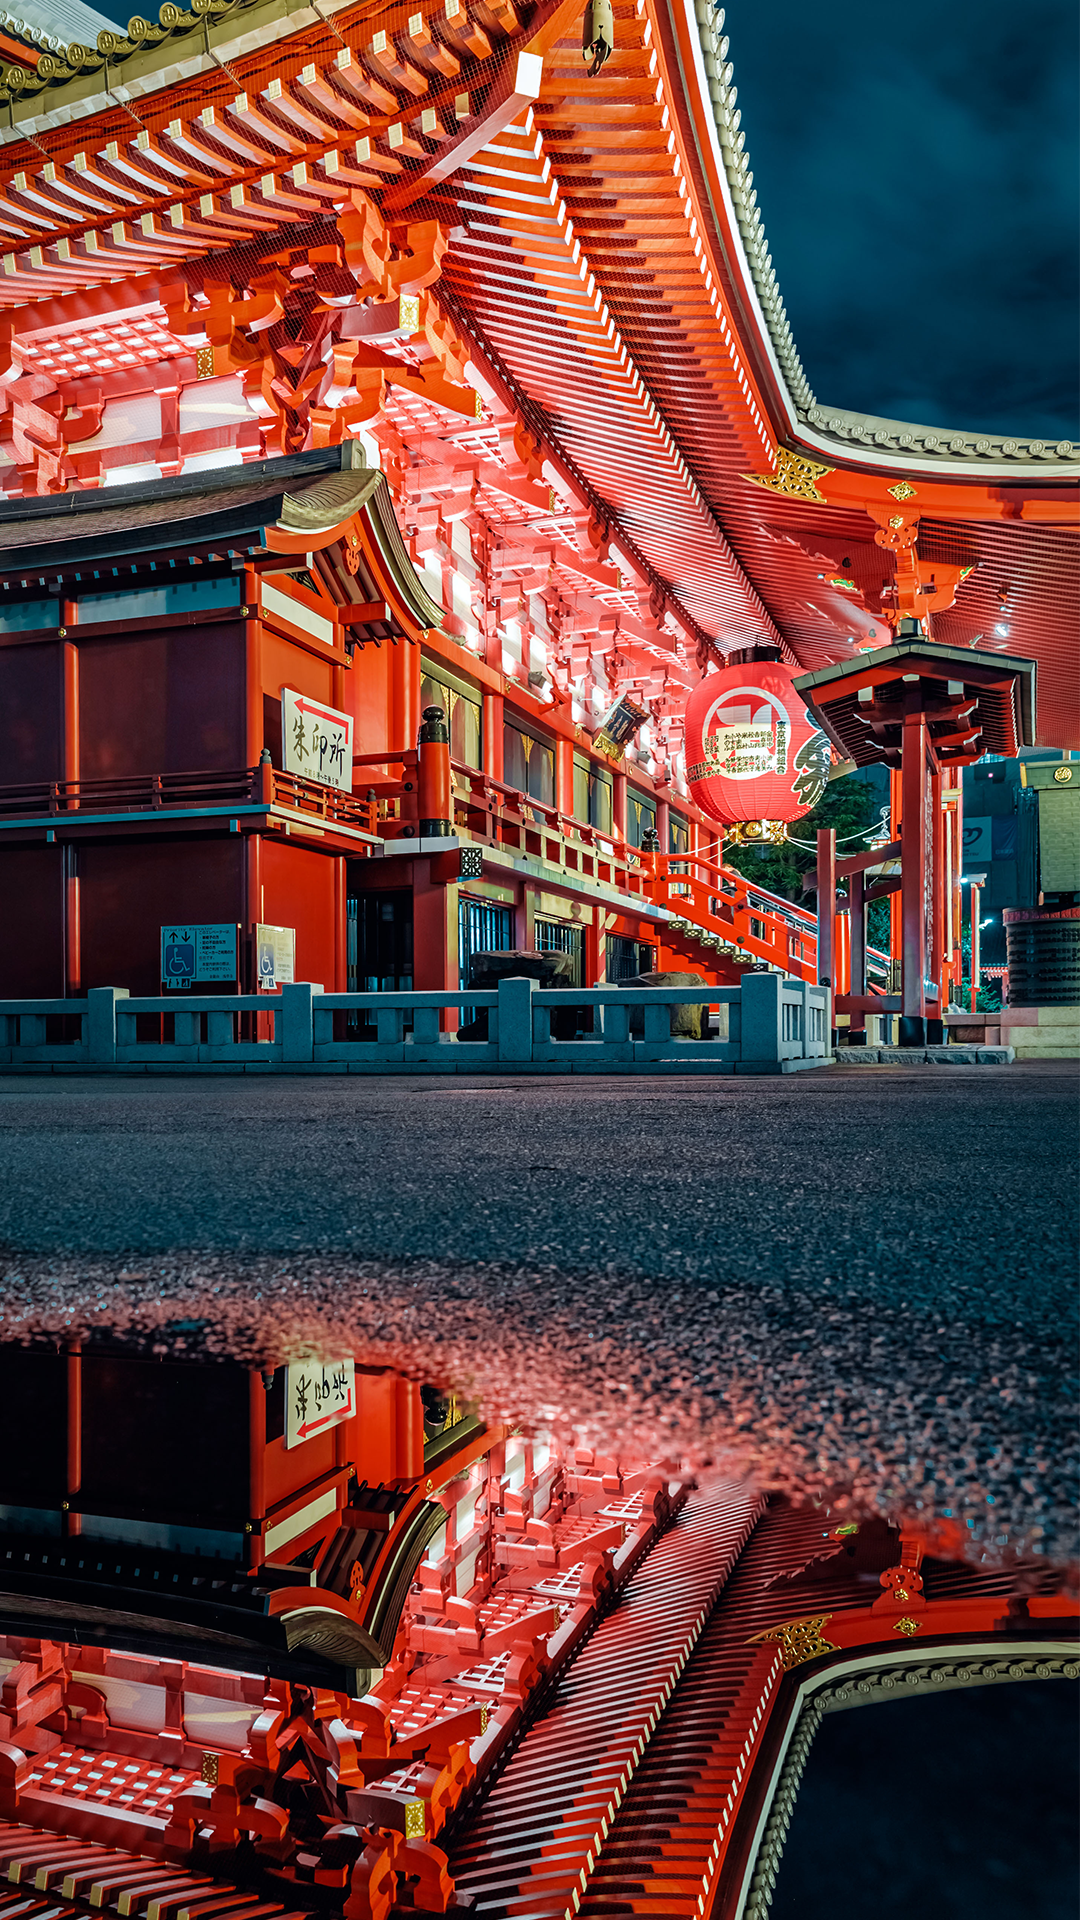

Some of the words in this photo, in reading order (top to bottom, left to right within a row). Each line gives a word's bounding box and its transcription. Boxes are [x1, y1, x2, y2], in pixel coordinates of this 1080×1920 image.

[292, 715, 346, 777] 朱印所
[776, 720, 786, 775] 東京新橋組合
